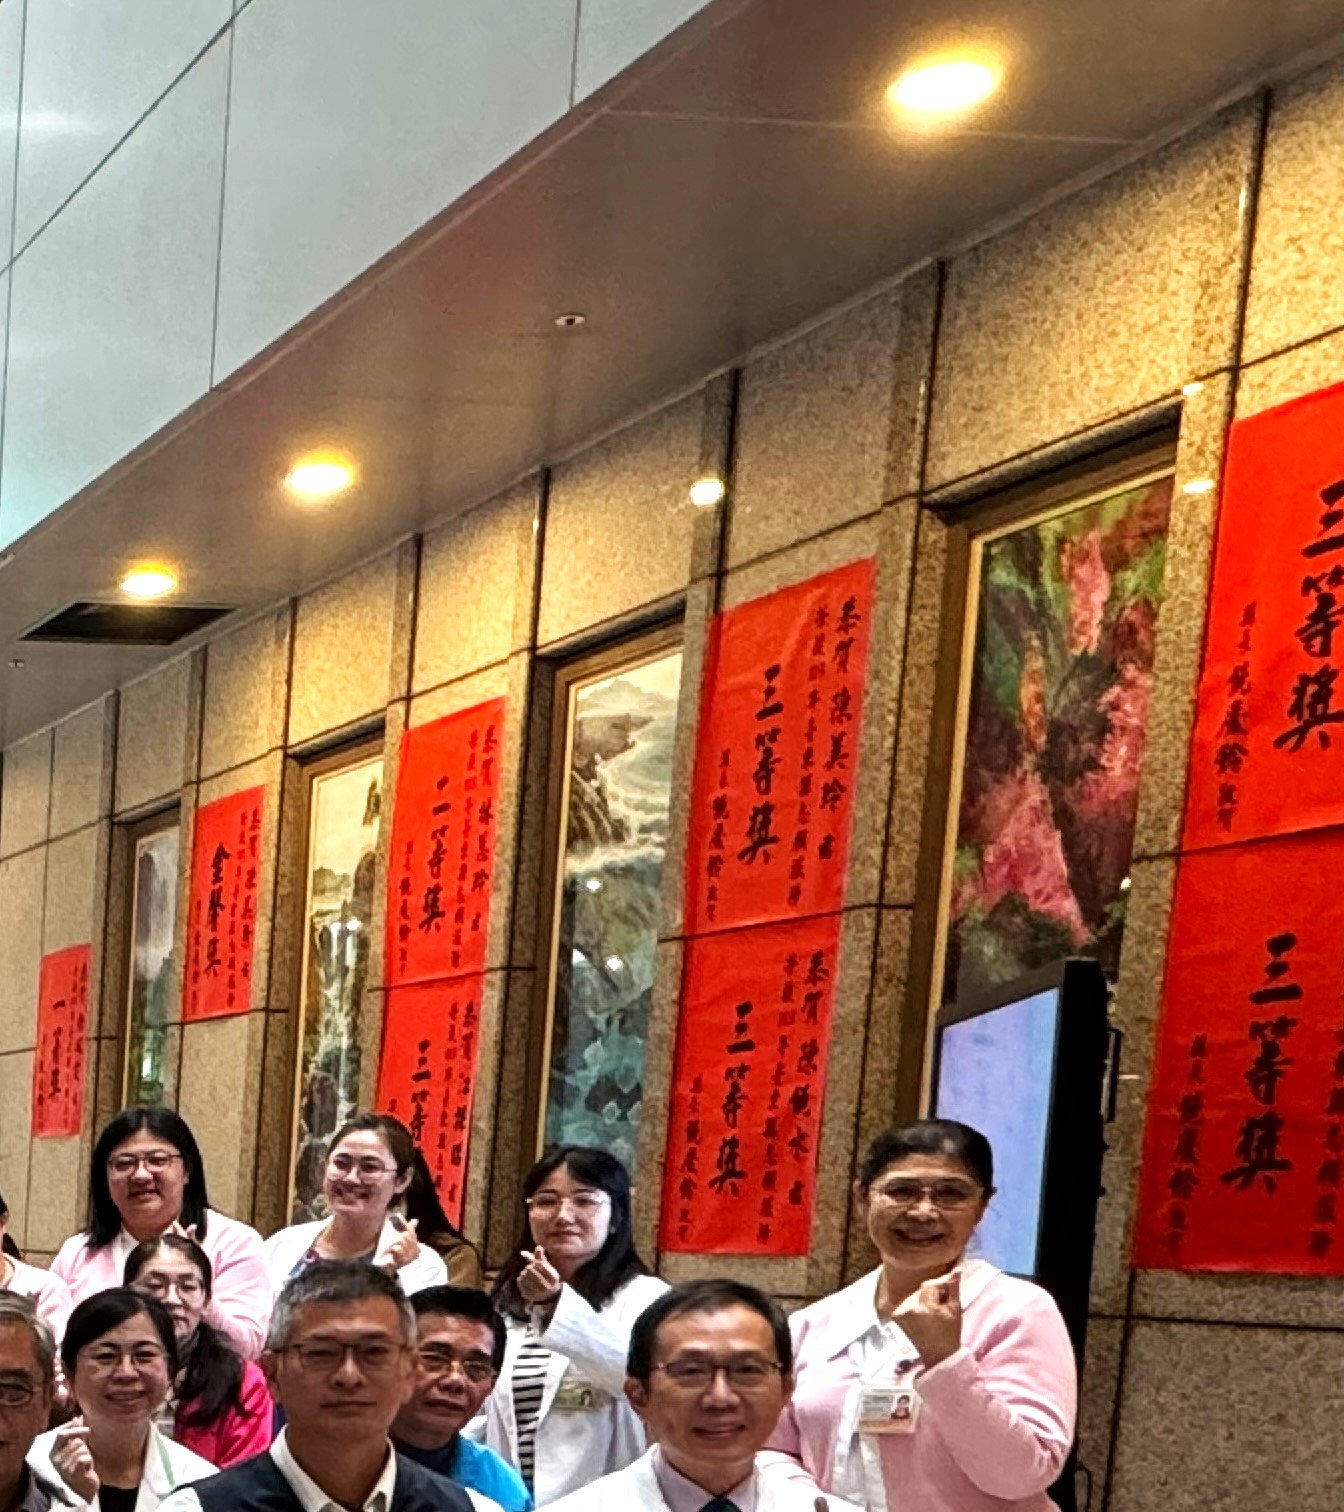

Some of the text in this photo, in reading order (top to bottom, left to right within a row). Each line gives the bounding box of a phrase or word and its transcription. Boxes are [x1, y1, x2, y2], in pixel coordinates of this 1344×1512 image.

[737, 664, 784, 866] 三等獎
[1219, 931, 1304, 1196] 三等獎
